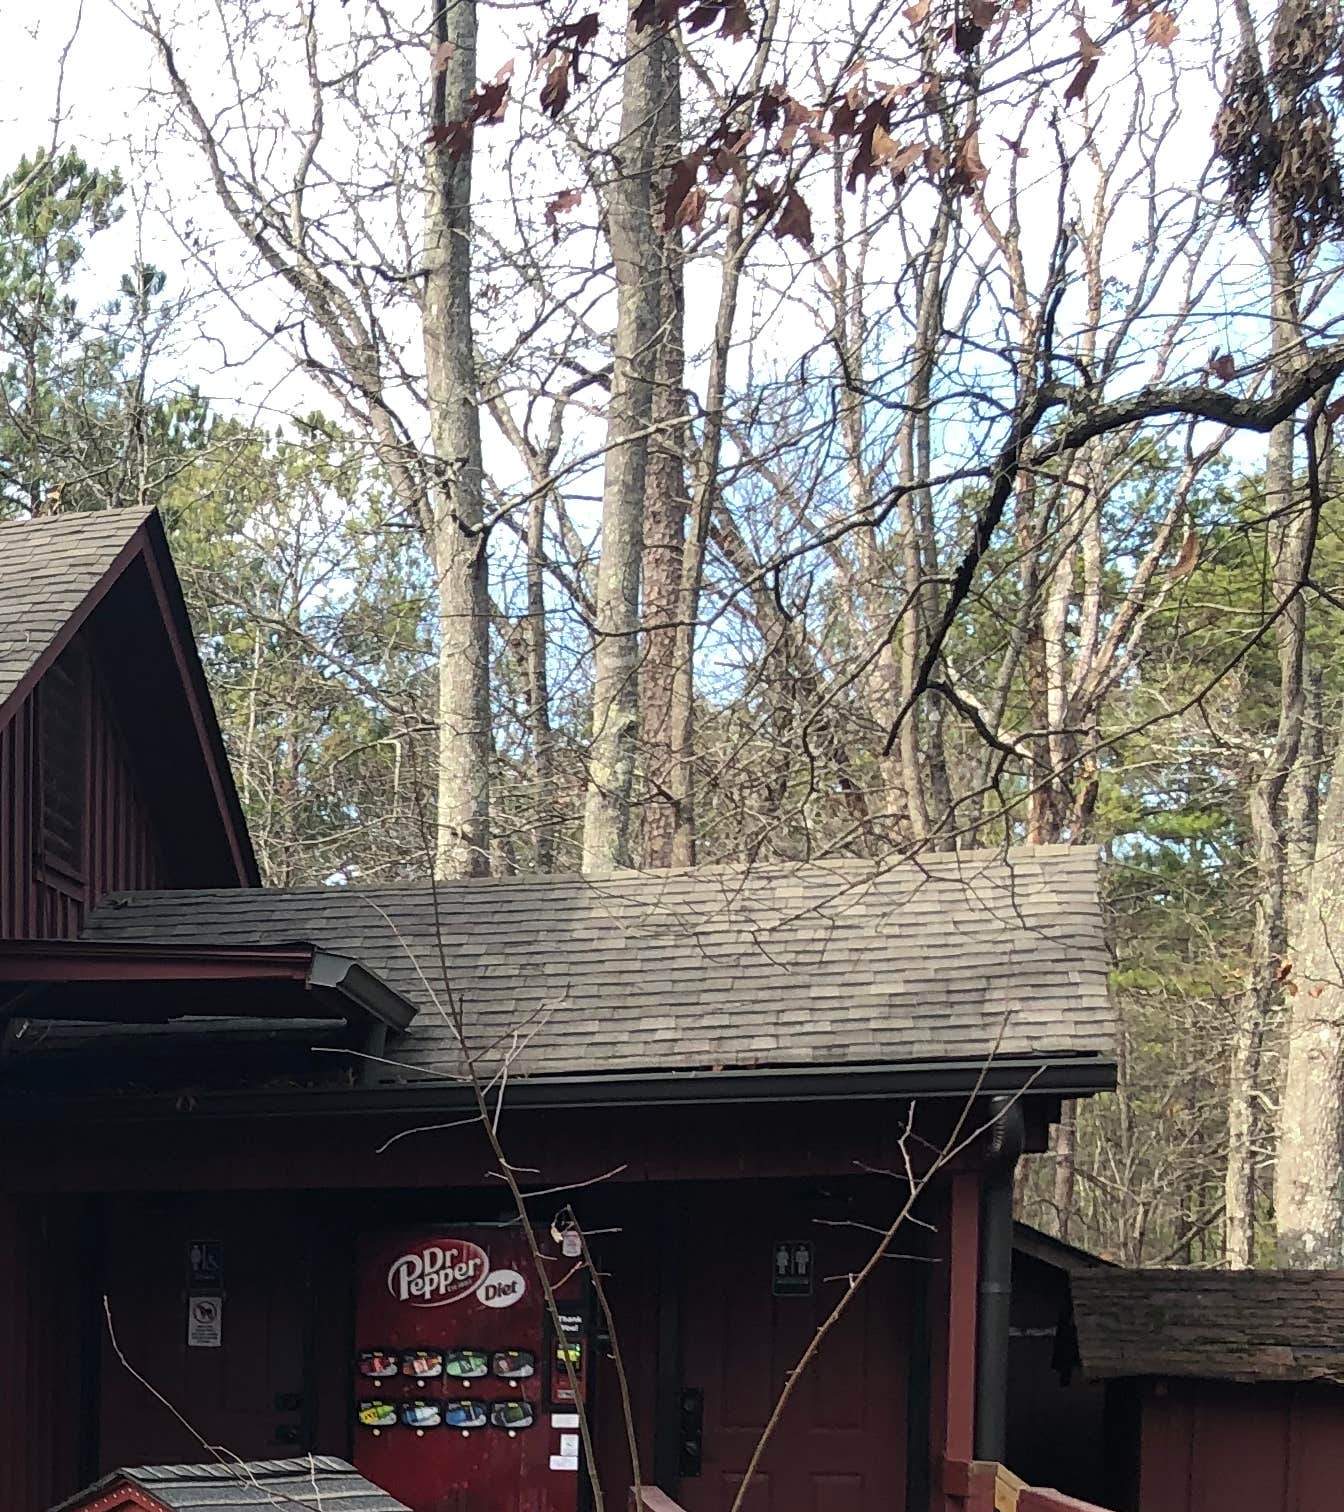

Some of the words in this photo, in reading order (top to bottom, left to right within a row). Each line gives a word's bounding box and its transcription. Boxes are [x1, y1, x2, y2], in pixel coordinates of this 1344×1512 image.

[423, 1247, 458, 1274] Dr
[395, 1254, 481, 1301] Pepper
[485, 1280, 519, 1301] Diet
